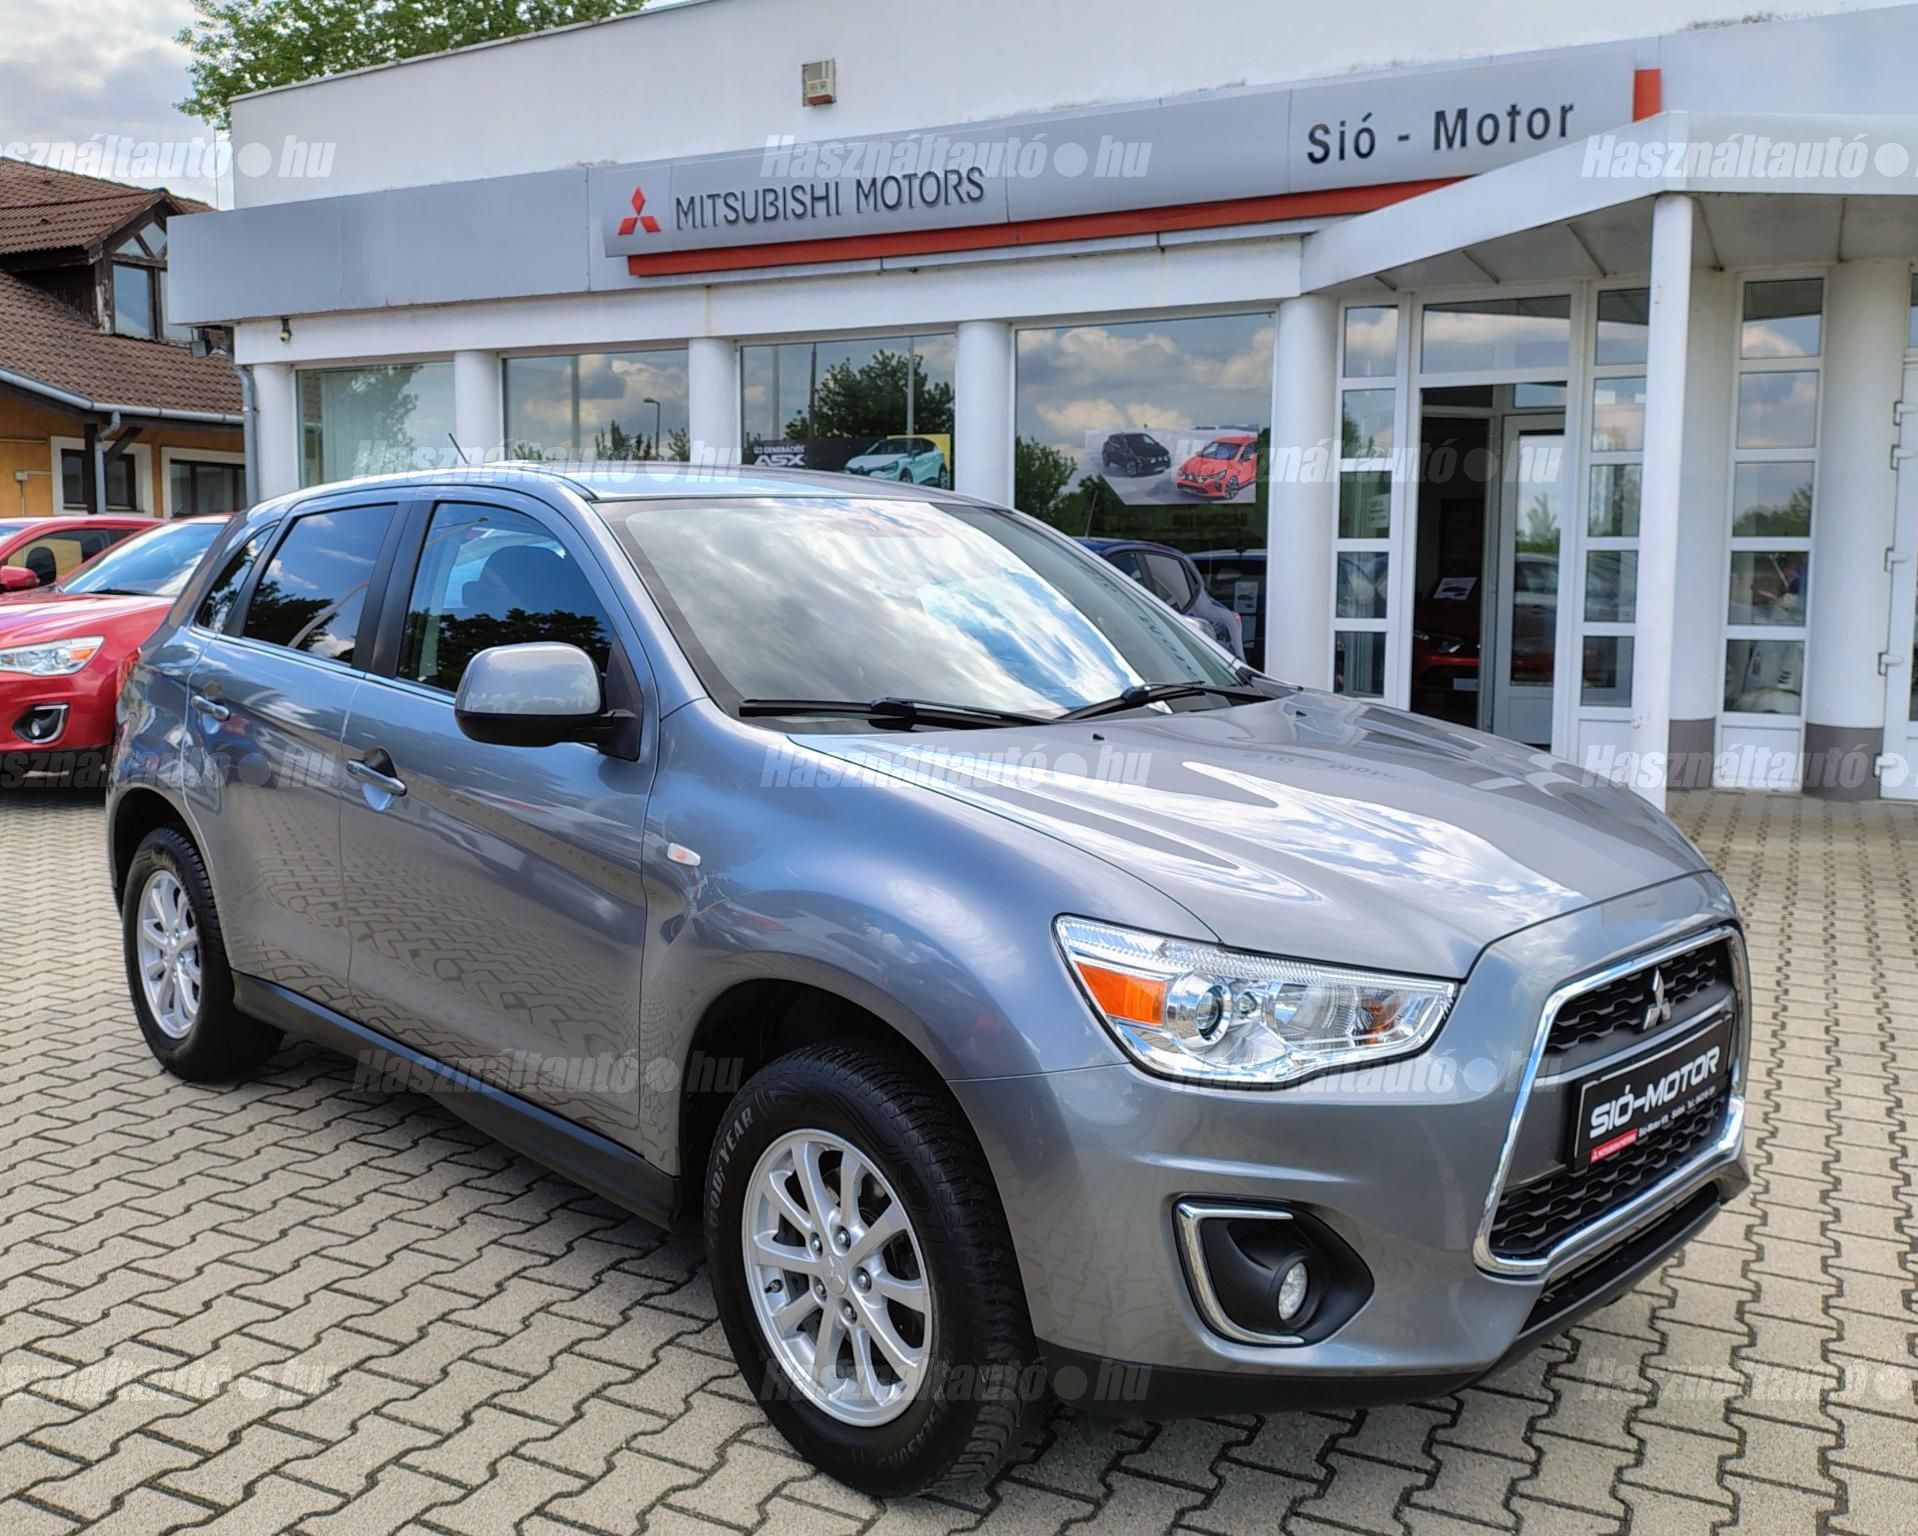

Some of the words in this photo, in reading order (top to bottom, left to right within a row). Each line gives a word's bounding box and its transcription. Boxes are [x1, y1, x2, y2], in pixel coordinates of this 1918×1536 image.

[1307, 112, 1376, 165] Sió
[1433, 103, 1575, 151] Motor
[675, 181, 842, 231] MITSUBISHI
[855, 166, 985, 214] MOTORS
[754, 454, 807, 467] ASX
[1589, 1046, 1720, 1139] SIÓ-MOTOR
